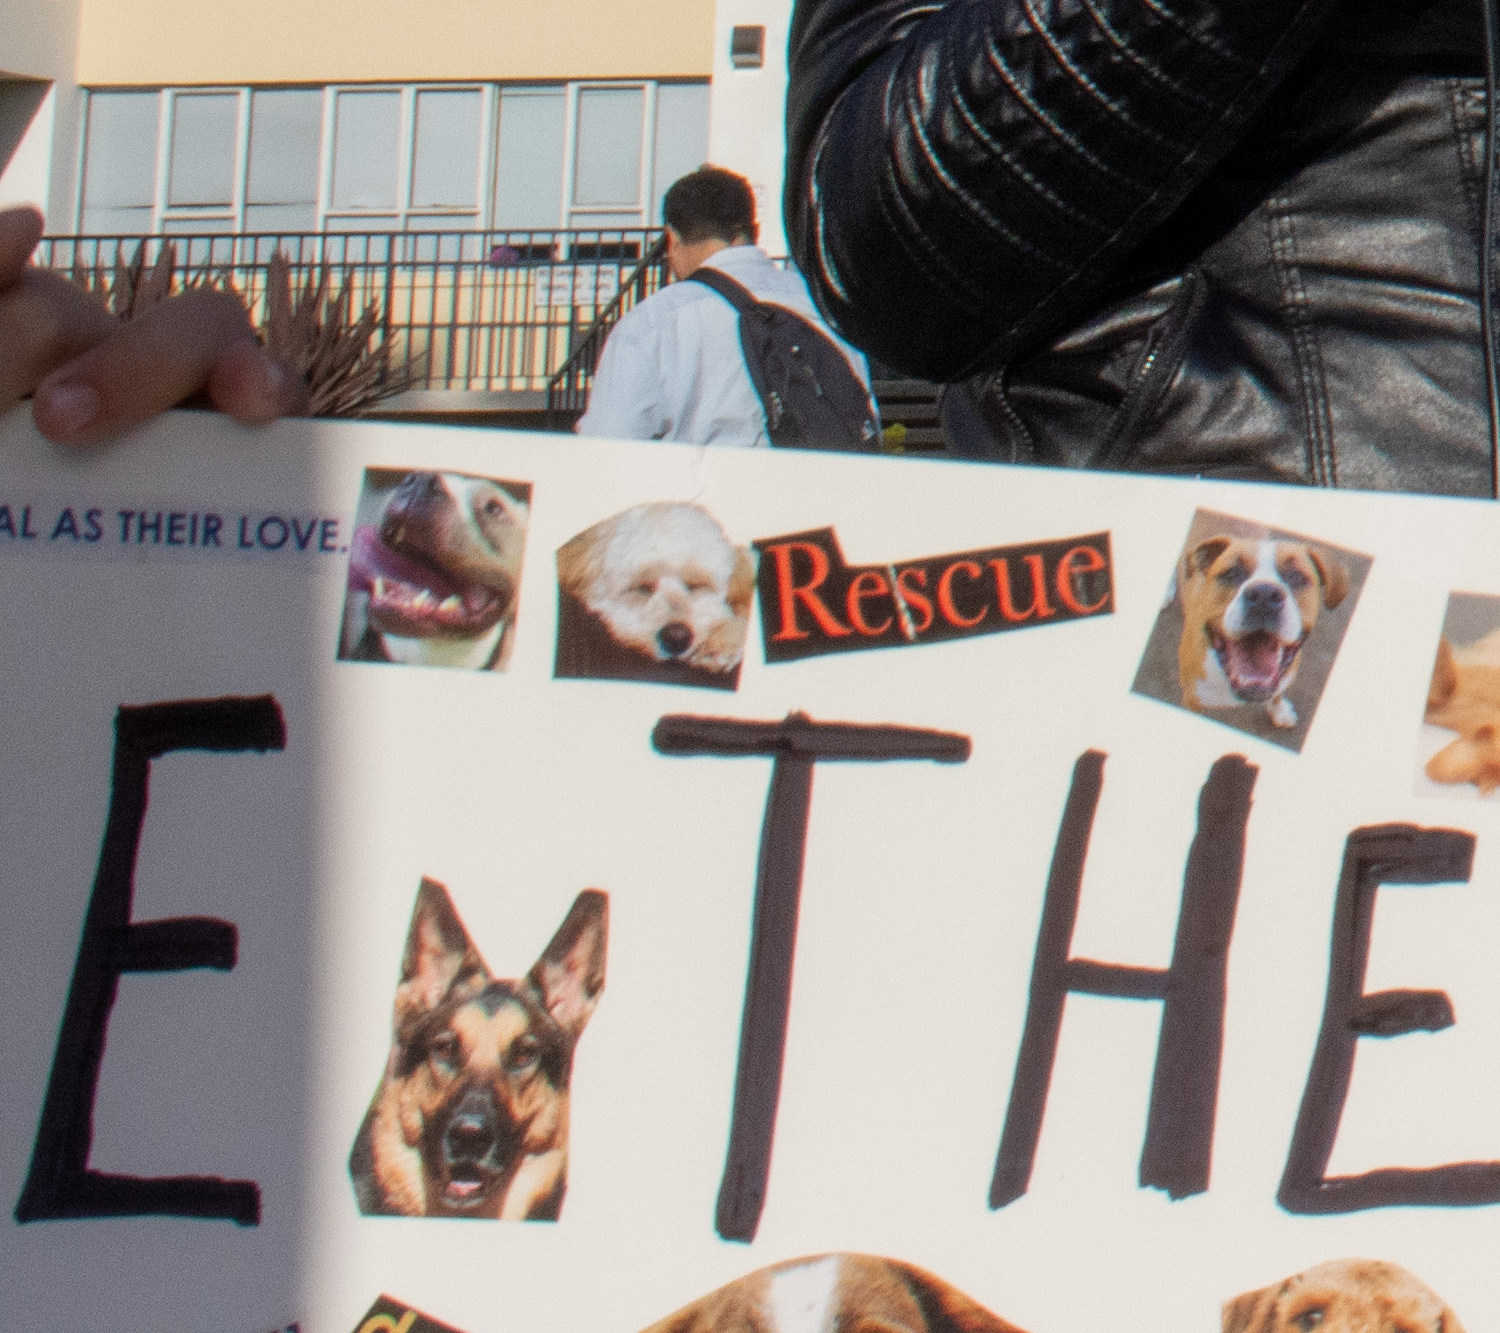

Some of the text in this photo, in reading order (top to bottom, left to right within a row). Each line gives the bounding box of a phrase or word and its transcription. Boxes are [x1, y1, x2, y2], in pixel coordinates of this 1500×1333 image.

[50, 506, 103, 542] AS
[117, 509, 224, 548] THEIR
[236, 515, 348, 554] LOVE.
[771, 539, 1112, 643] Rescue
